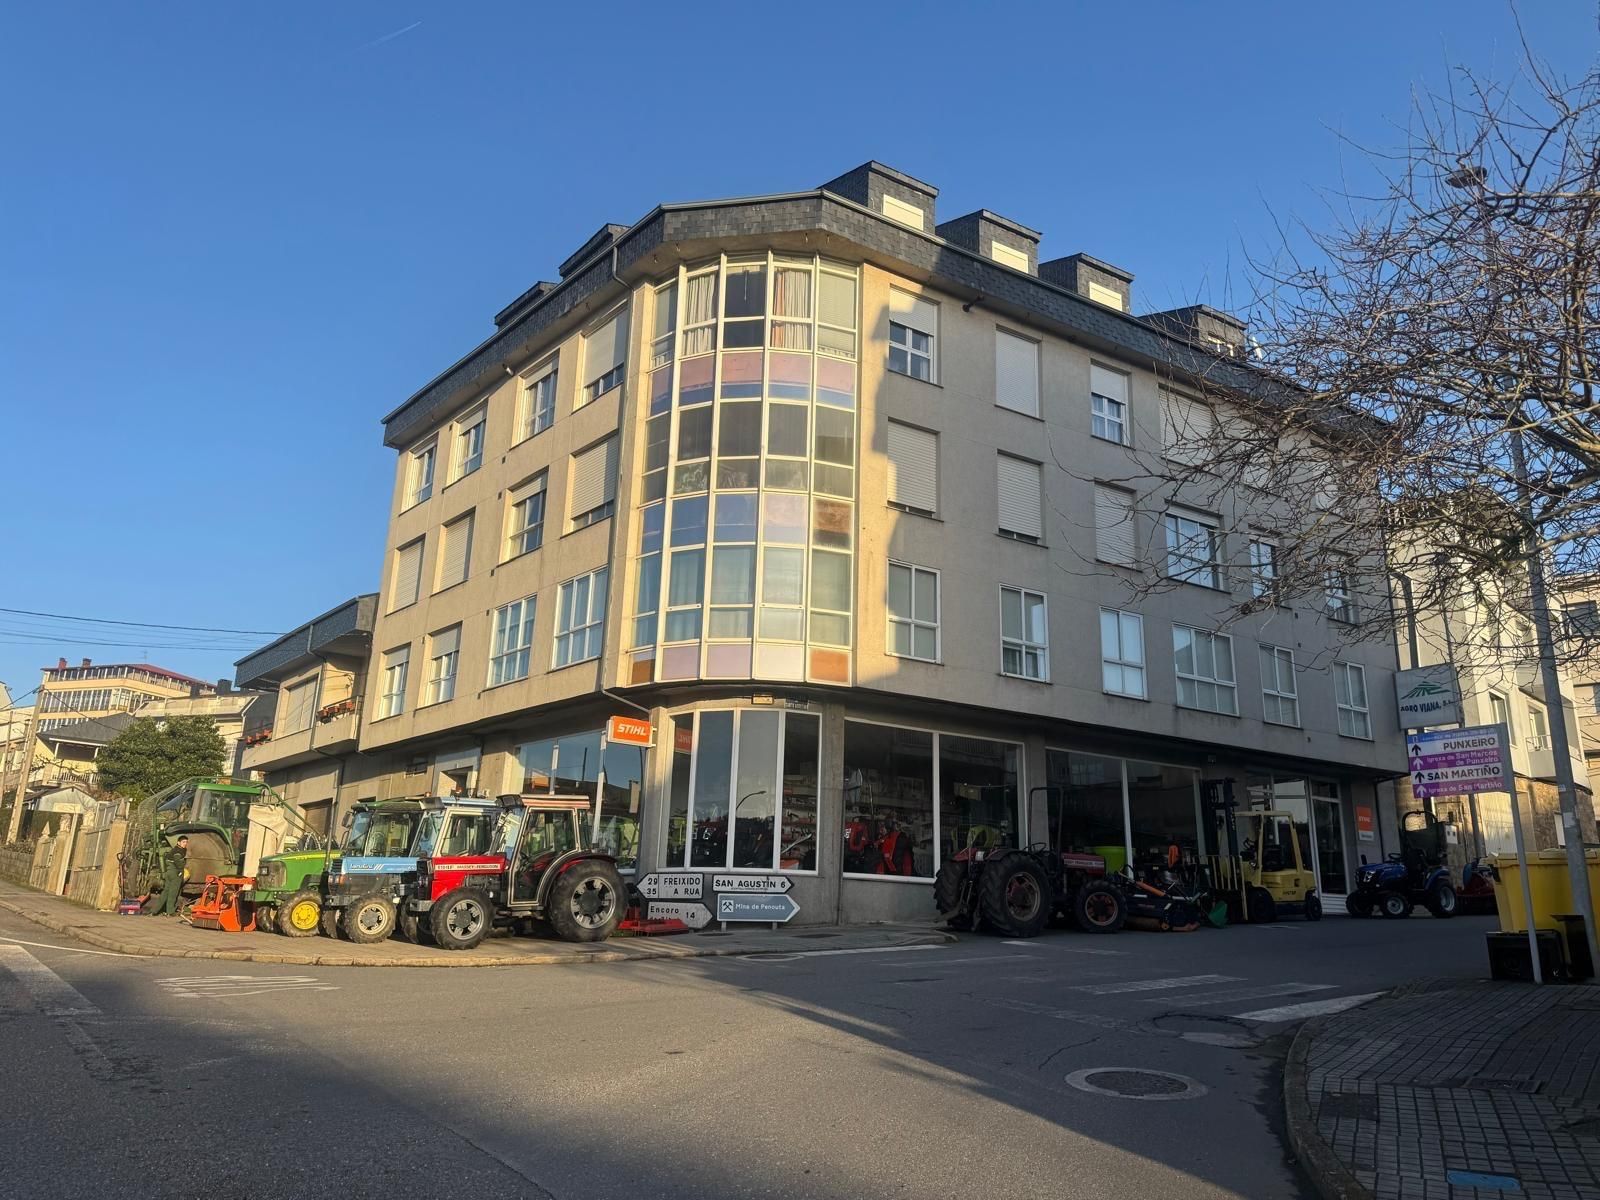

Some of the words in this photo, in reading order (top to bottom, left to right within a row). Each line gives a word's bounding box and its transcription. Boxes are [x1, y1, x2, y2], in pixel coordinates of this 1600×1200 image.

[1400, 704, 1418, 712] AGRO
[617, 723, 647, 736] STIHL
[1443, 737, 1496, 751] PUNXEIRO
[1470, 750, 1498, 758] Marcos
[1427, 771, 1449, 781] SAN
[1451, 765, 1500, 779] MARTIÑO
[647, 877, 658, 886] 29
[663, 877, 701, 886] FREIXIDO
[715, 879, 734, 888] SAN
[780, 881, 786, 889] 6
[650, 905, 679, 914] Encoro
[686, 911, 696, 919] 14
